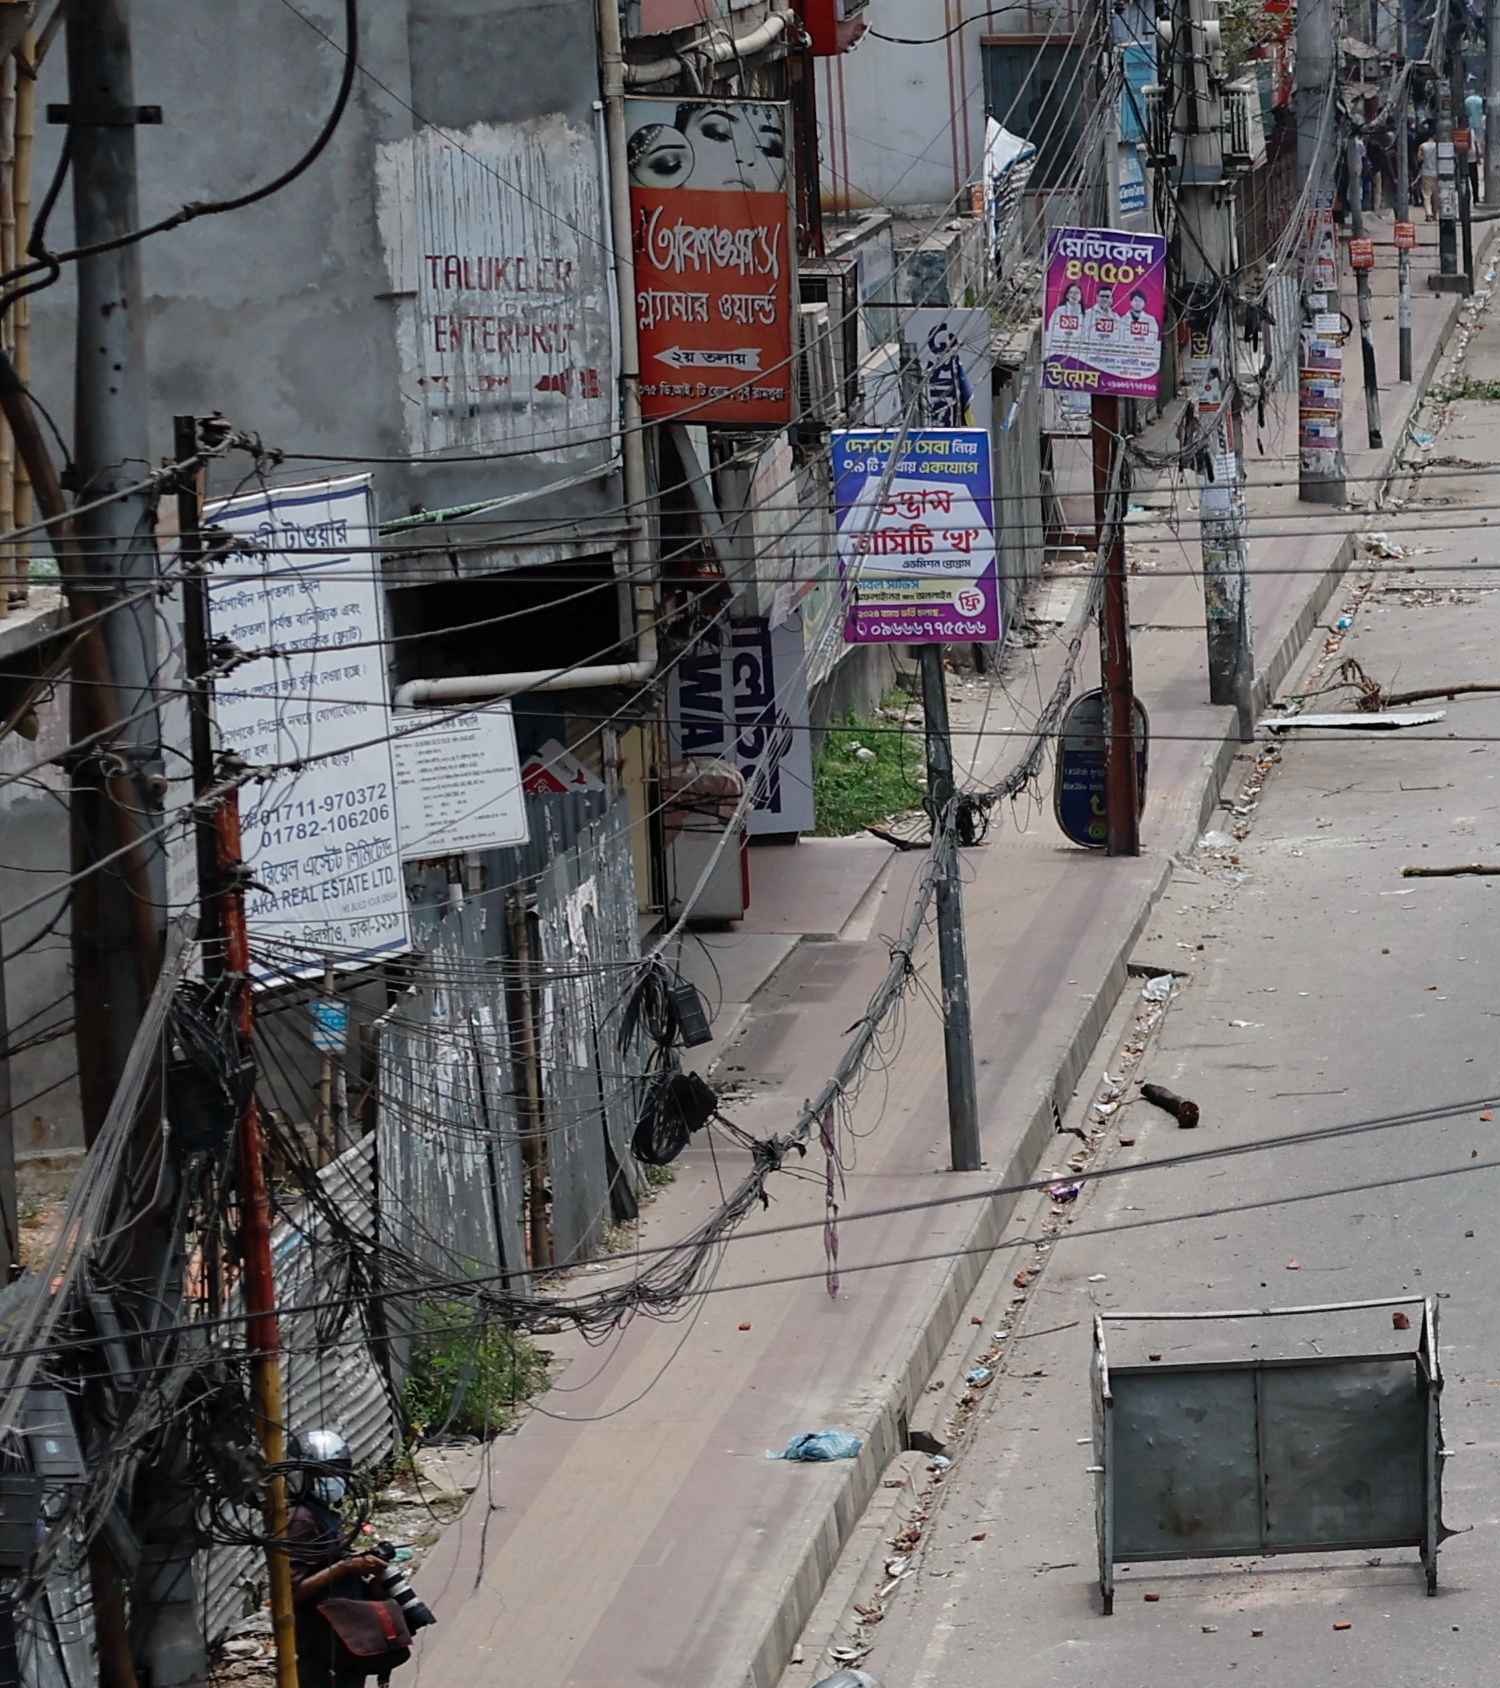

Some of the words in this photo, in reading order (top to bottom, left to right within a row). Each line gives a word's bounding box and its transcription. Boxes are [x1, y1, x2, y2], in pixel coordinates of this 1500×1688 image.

[1058, 233, 1154, 263] মেডিকেল
[261, 783, 388, 827] 01711-970372
[261, 804, 390, 849] 01782-106206
[283, 884, 319, 910] REAL
[322, 872, 369, 900] ESTATE
